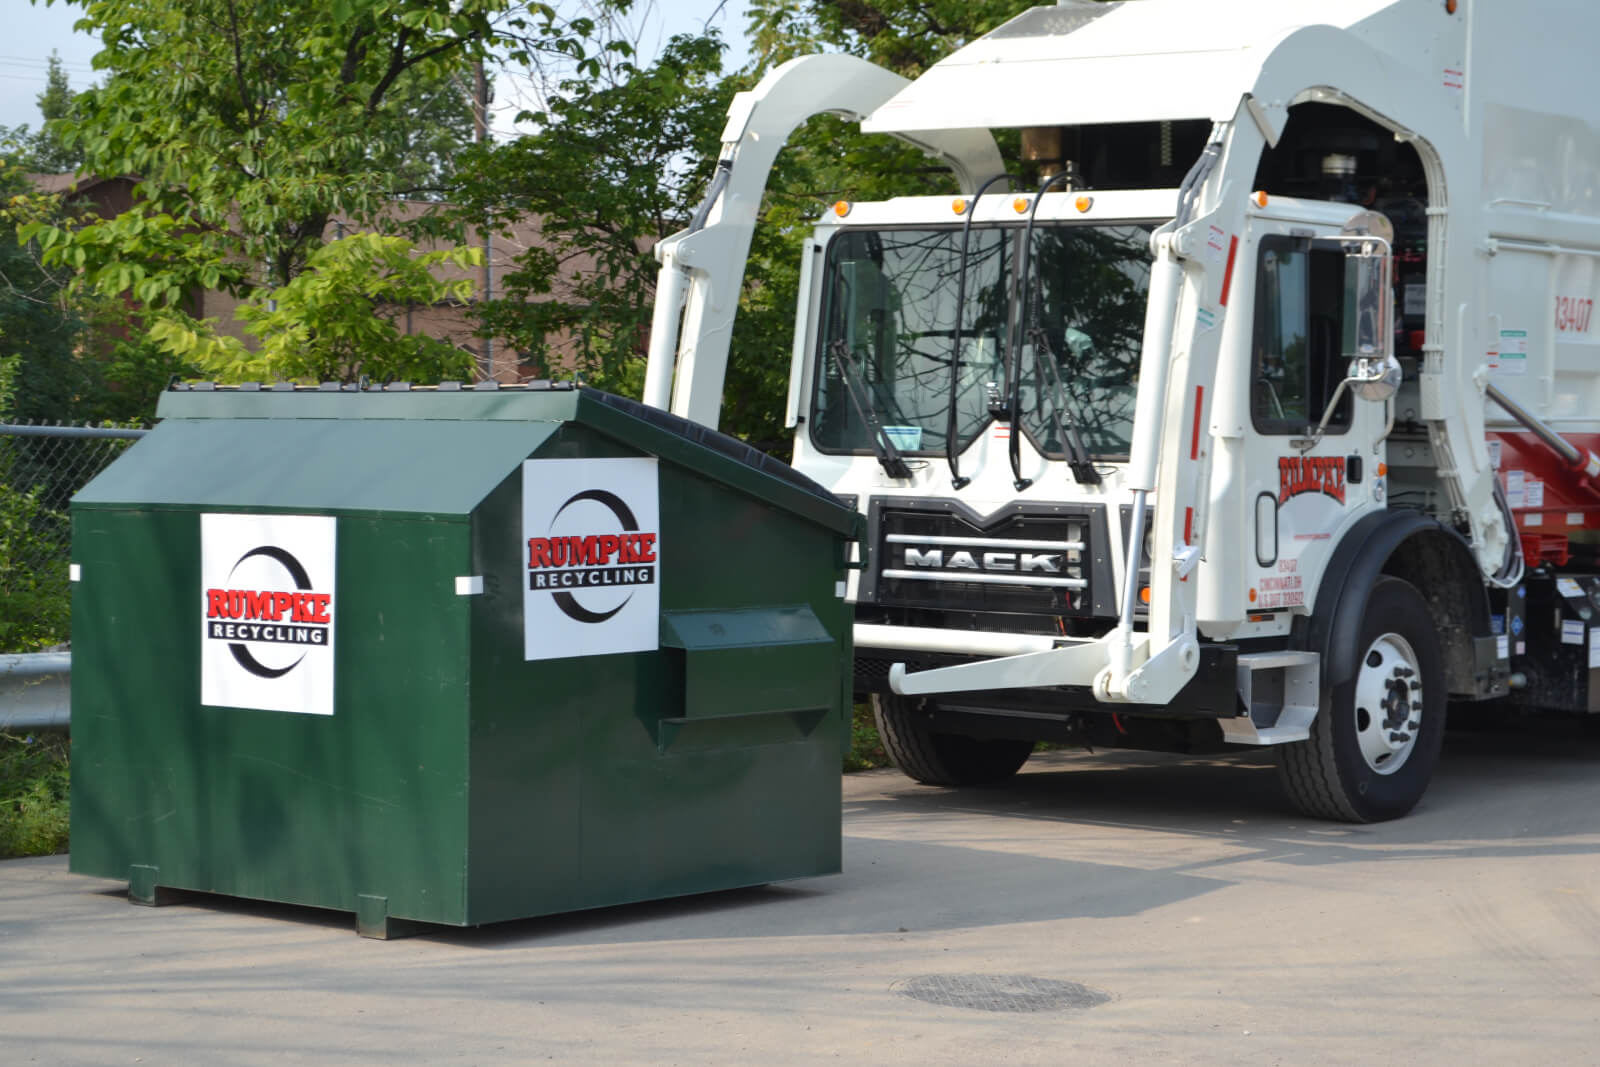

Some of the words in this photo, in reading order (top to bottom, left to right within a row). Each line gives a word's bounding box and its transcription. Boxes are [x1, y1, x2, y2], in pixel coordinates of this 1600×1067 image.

[1278, 456, 1346, 507] RUMPKE
[528, 533, 657, 569] RUMPKE
[905, 548, 1061, 573] MACK
[535, 569, 649, 588] RECYCLING
[207, 589, 331, 624] RUMPKE
[213, 623, 323, 643] RECYCLING
